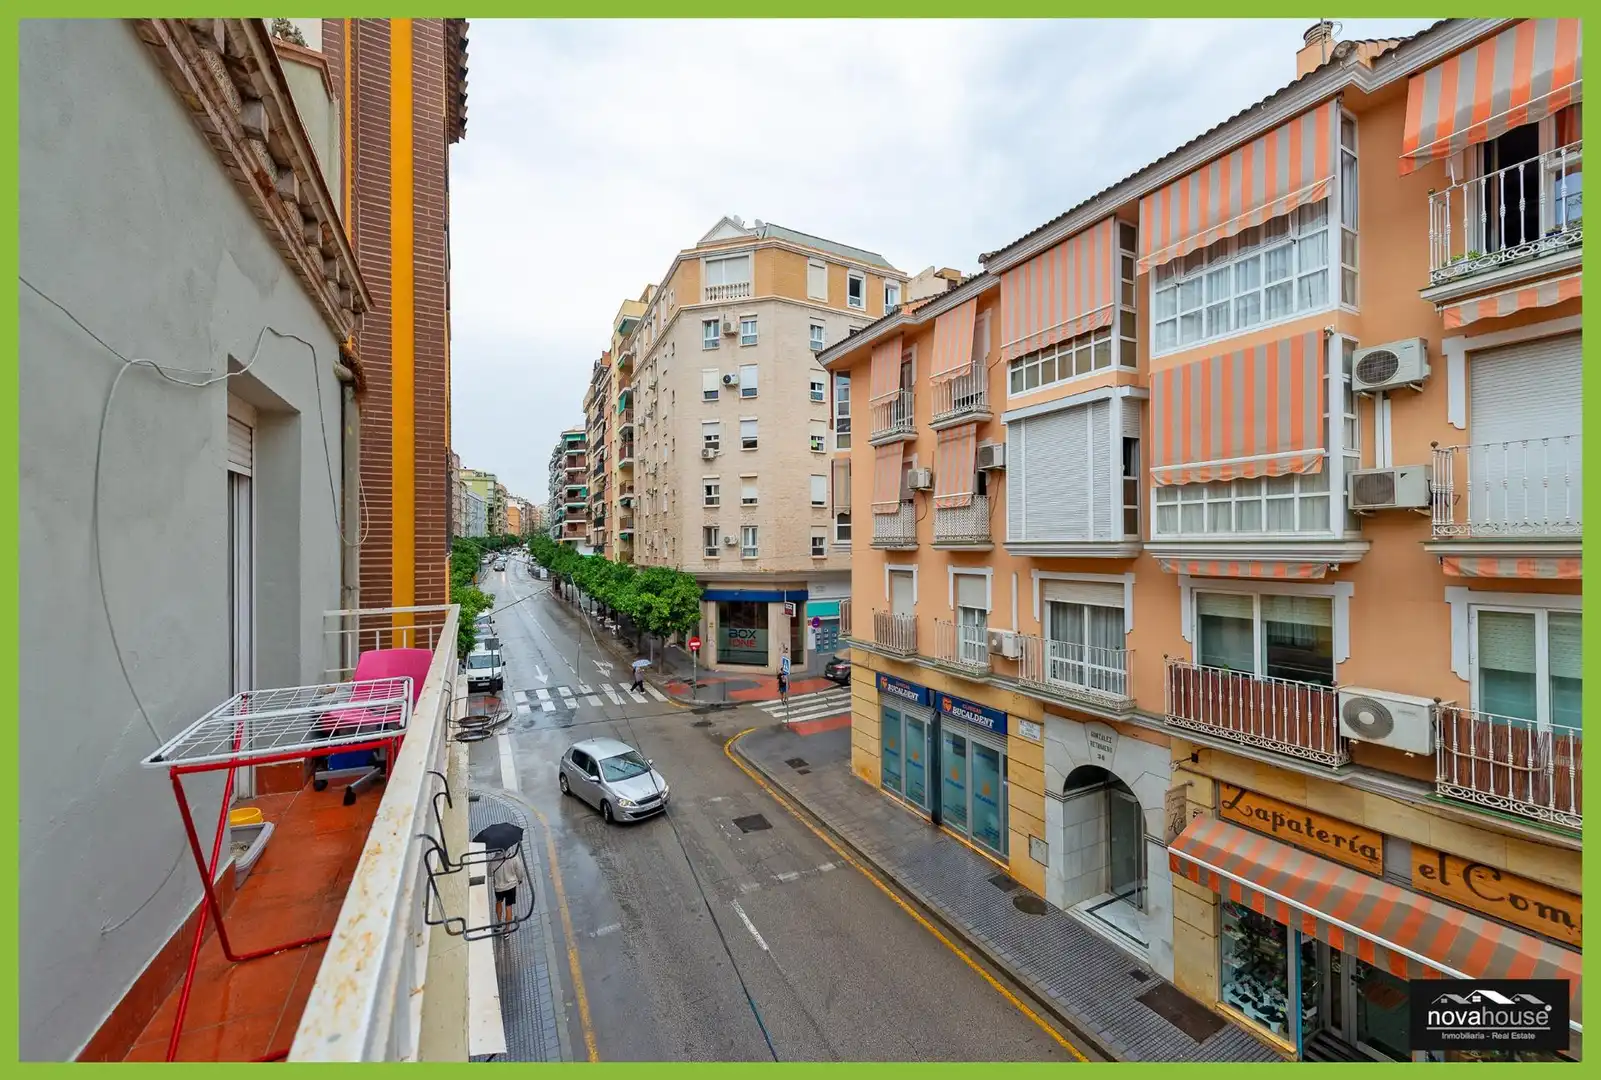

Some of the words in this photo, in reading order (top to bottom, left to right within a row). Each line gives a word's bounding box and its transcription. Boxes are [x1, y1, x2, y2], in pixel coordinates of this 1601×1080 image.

[729, 628, 757, 639] BOX
[887, 683, 919, 702] BUCALDENT
[952, 706, 995, 729] BUCALDENT
[1221, 781, 1380, 861] Zapatería
[1419, 853, 1451, 885] el
[1462, 862, 1583, 933] Com
